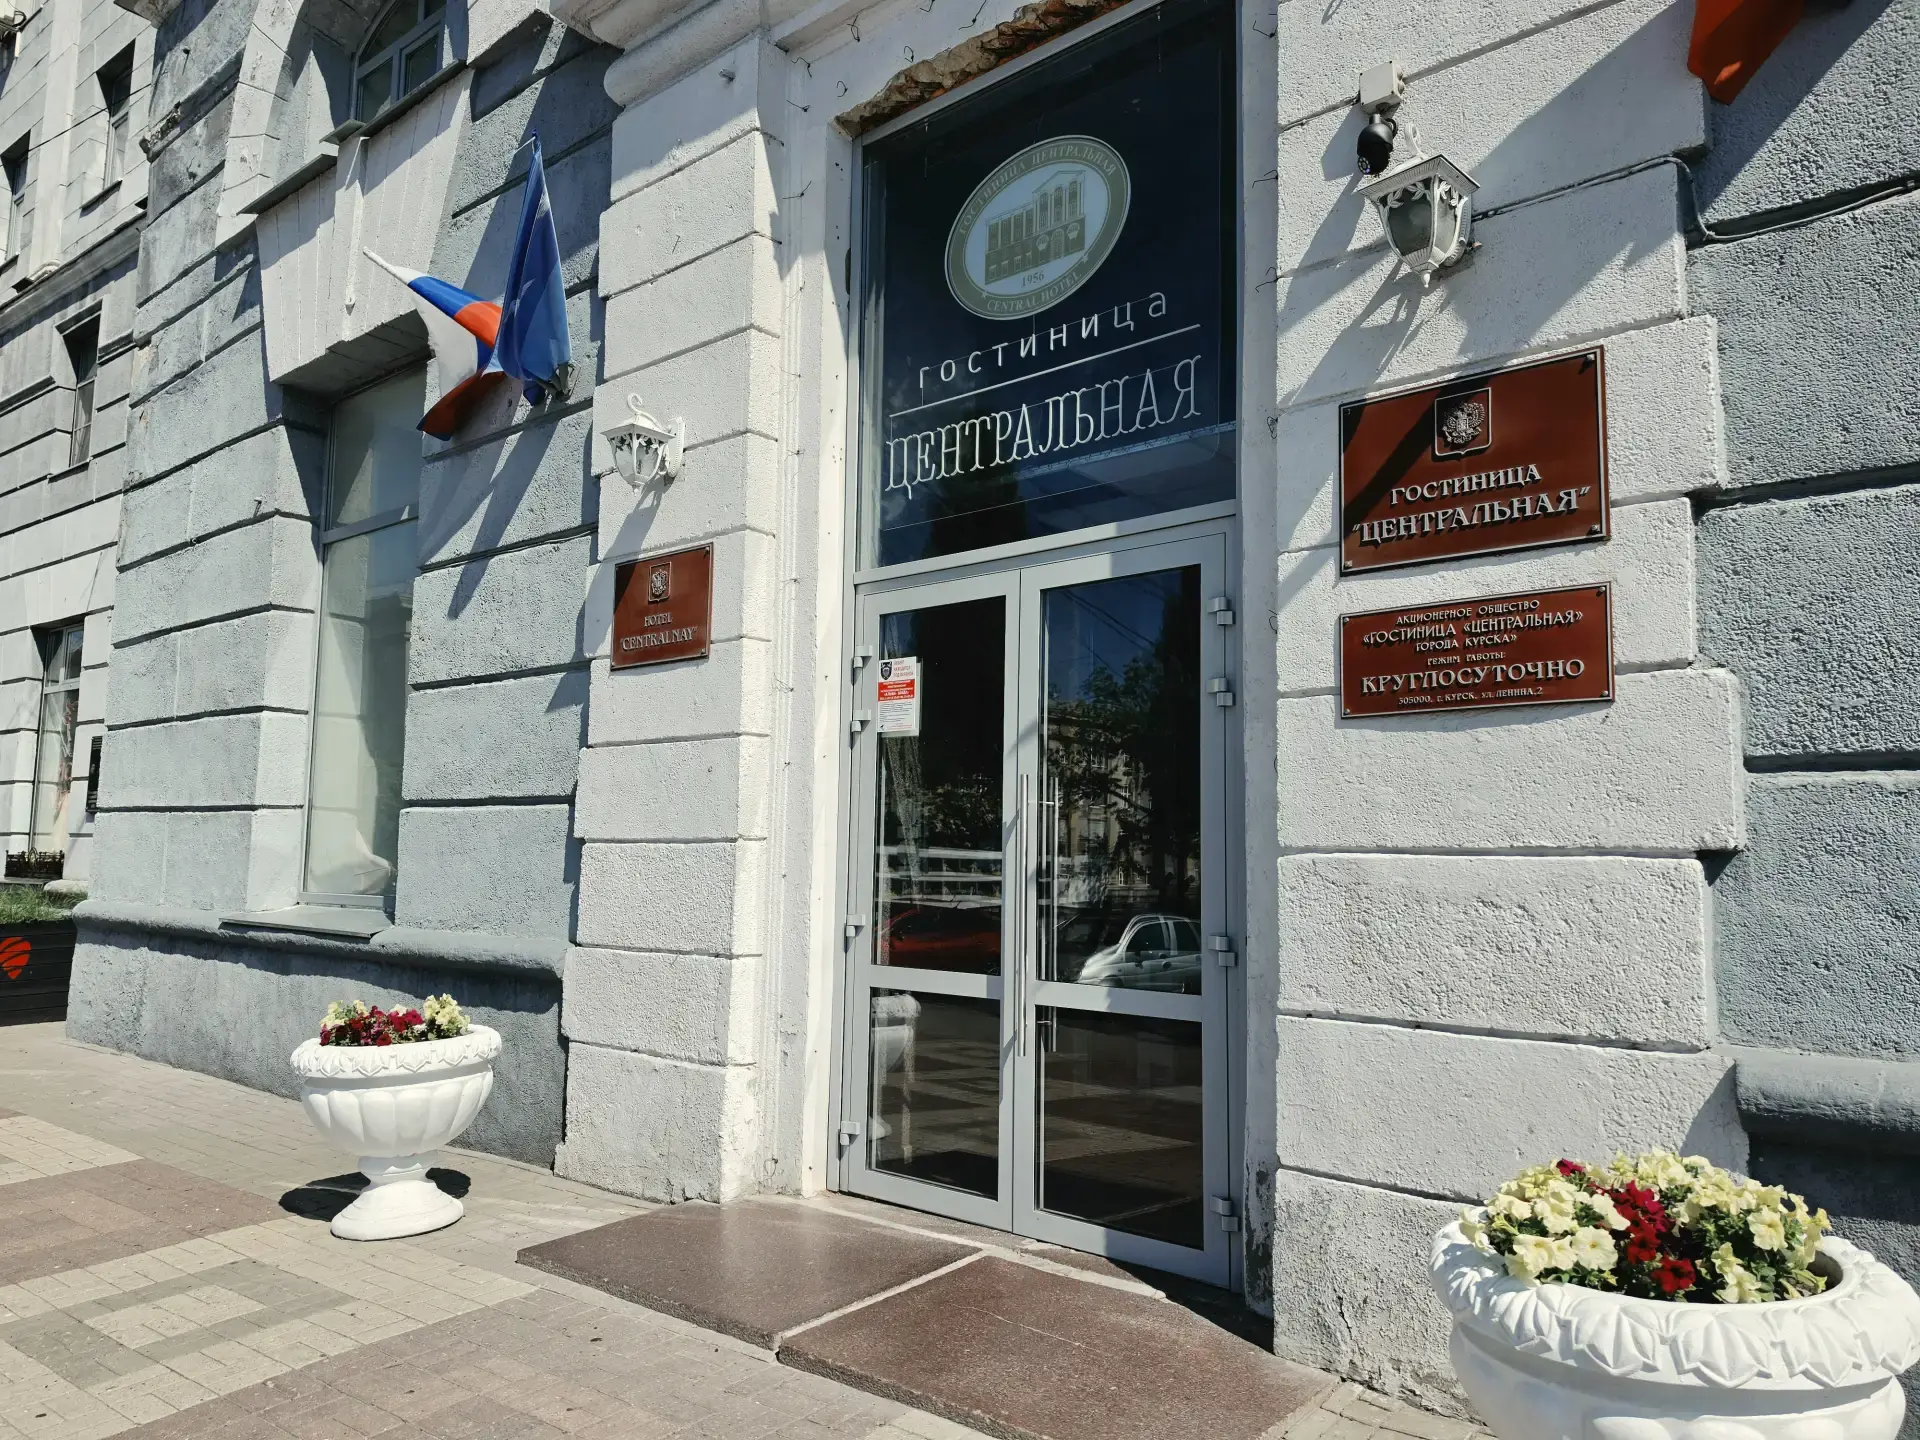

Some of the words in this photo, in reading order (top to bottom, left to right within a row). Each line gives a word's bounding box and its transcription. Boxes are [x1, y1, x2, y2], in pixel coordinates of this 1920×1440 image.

[987, 290, 1041, 313] CENTRAL
[1040, 271, 1082, 306] HOTEL
[1021, 272, 1045, 289] 1956
[919, 291, 1167, 389] гостиница
[885, 354, 1202, 500] ЦЕНТРАЛЬНАЯ
[1390, 464, 1542, 505] ГОСТИНИЦА
[644, 612, 673, 627] HOTEL
[1395, 607, 1473, 626] АКЦИОНЕРНОЕ
[1478, 600, 1540, 615] ОБЩЕСТВО
[1416, 639, 1459, 652] ГОРОДА
[1427, 655, 1460, 666] РЕЖИМ
[1361, 659, 1585, 694] КРУГЛОСУТОЧНО
